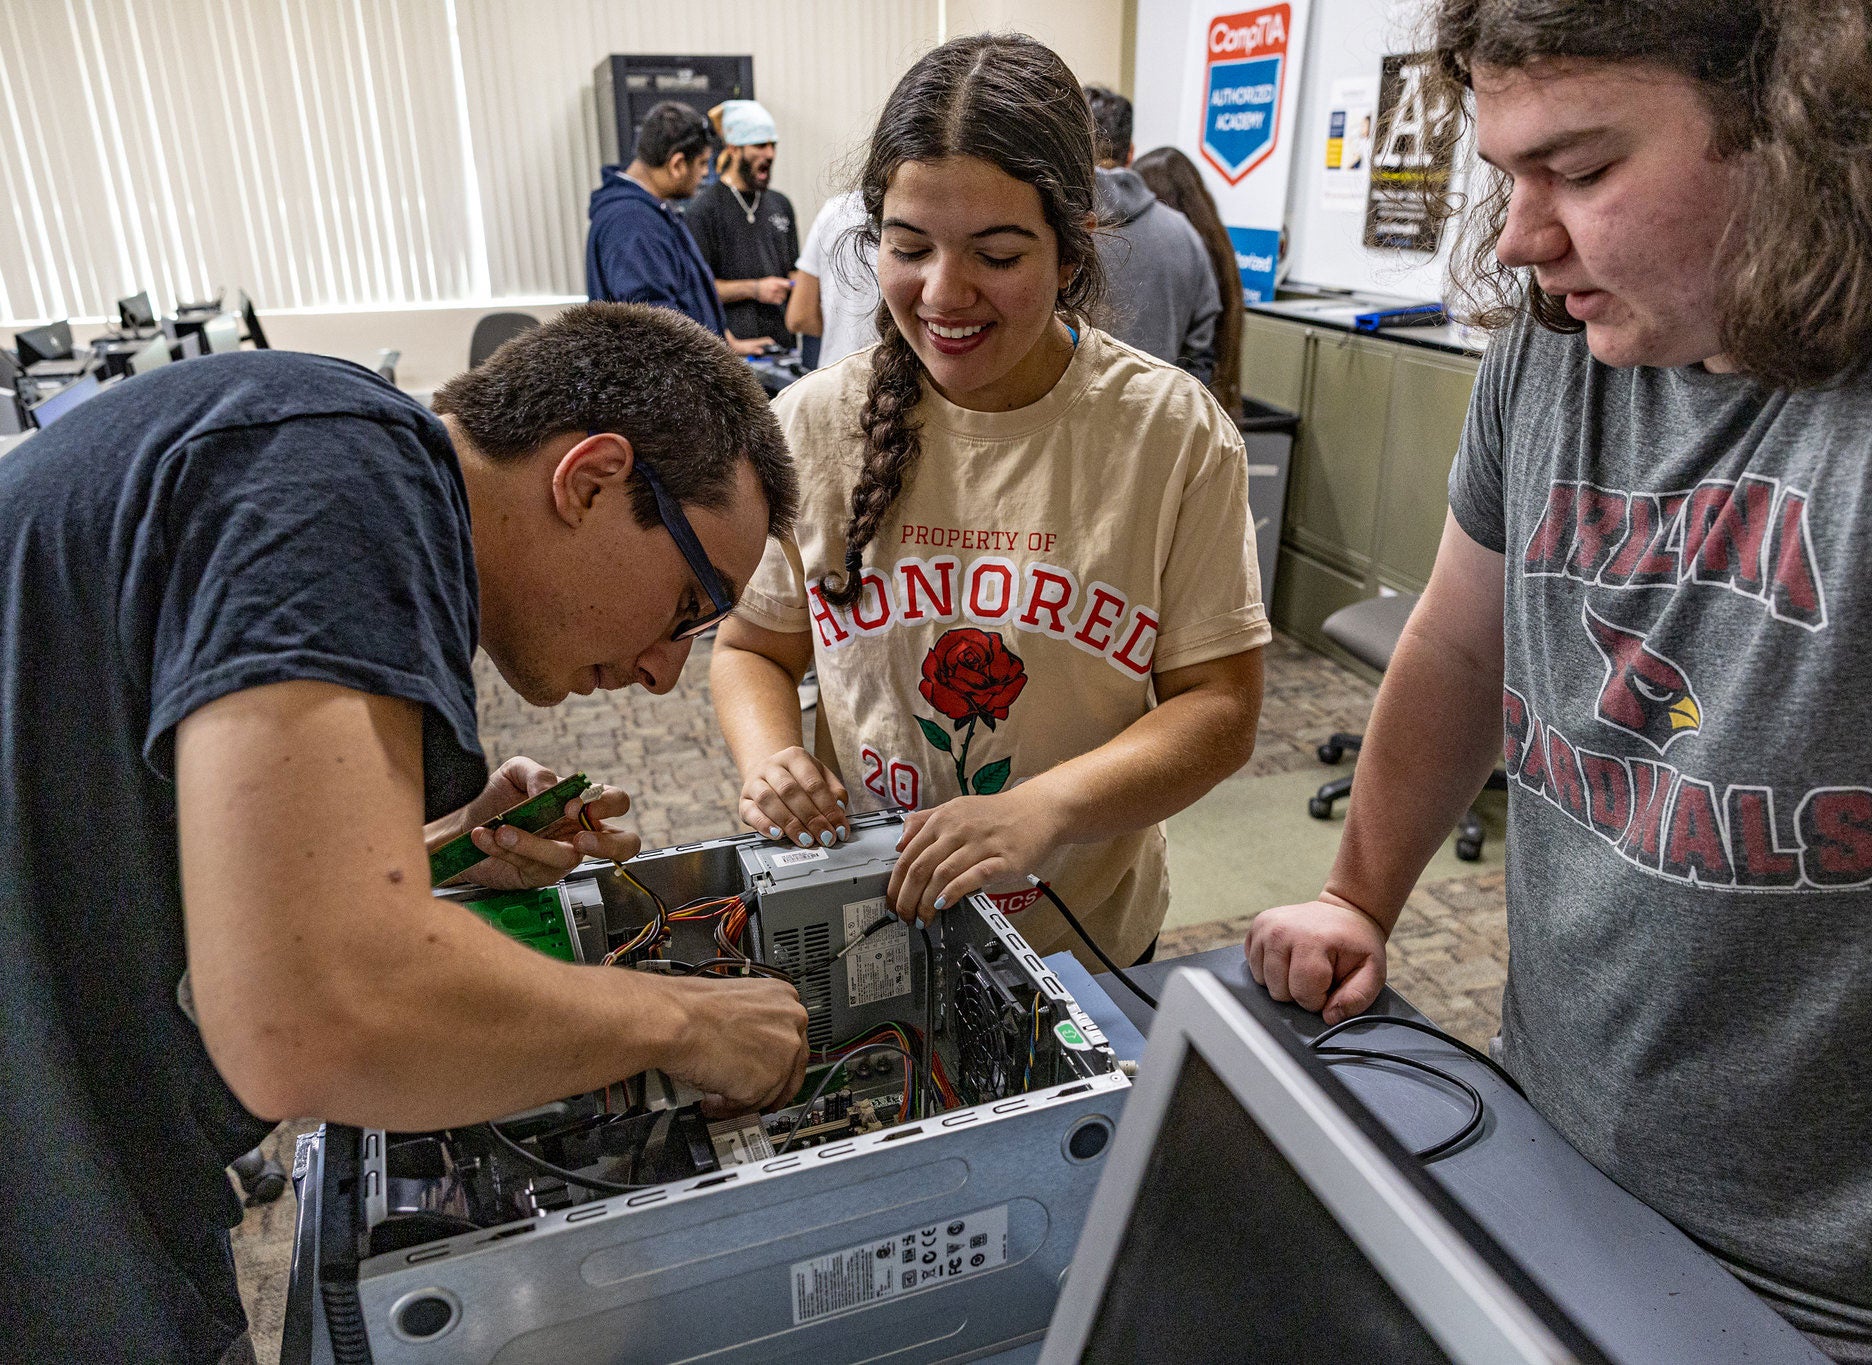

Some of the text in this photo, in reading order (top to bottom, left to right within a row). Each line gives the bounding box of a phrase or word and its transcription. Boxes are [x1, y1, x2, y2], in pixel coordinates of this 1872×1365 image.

[1209, 13, 1287, 56] CompTIA
[1210, 83, 1275, 107] AUTHORIZED
[1214, 110, 1265, 132] ACADEMY
[900, 524, 1058, 552] PROPERTY OF
[806, 557, 1160, 682] HONORED
[861, 748, 920, 812] 20
[993, 890, 1039, 914] ICS
